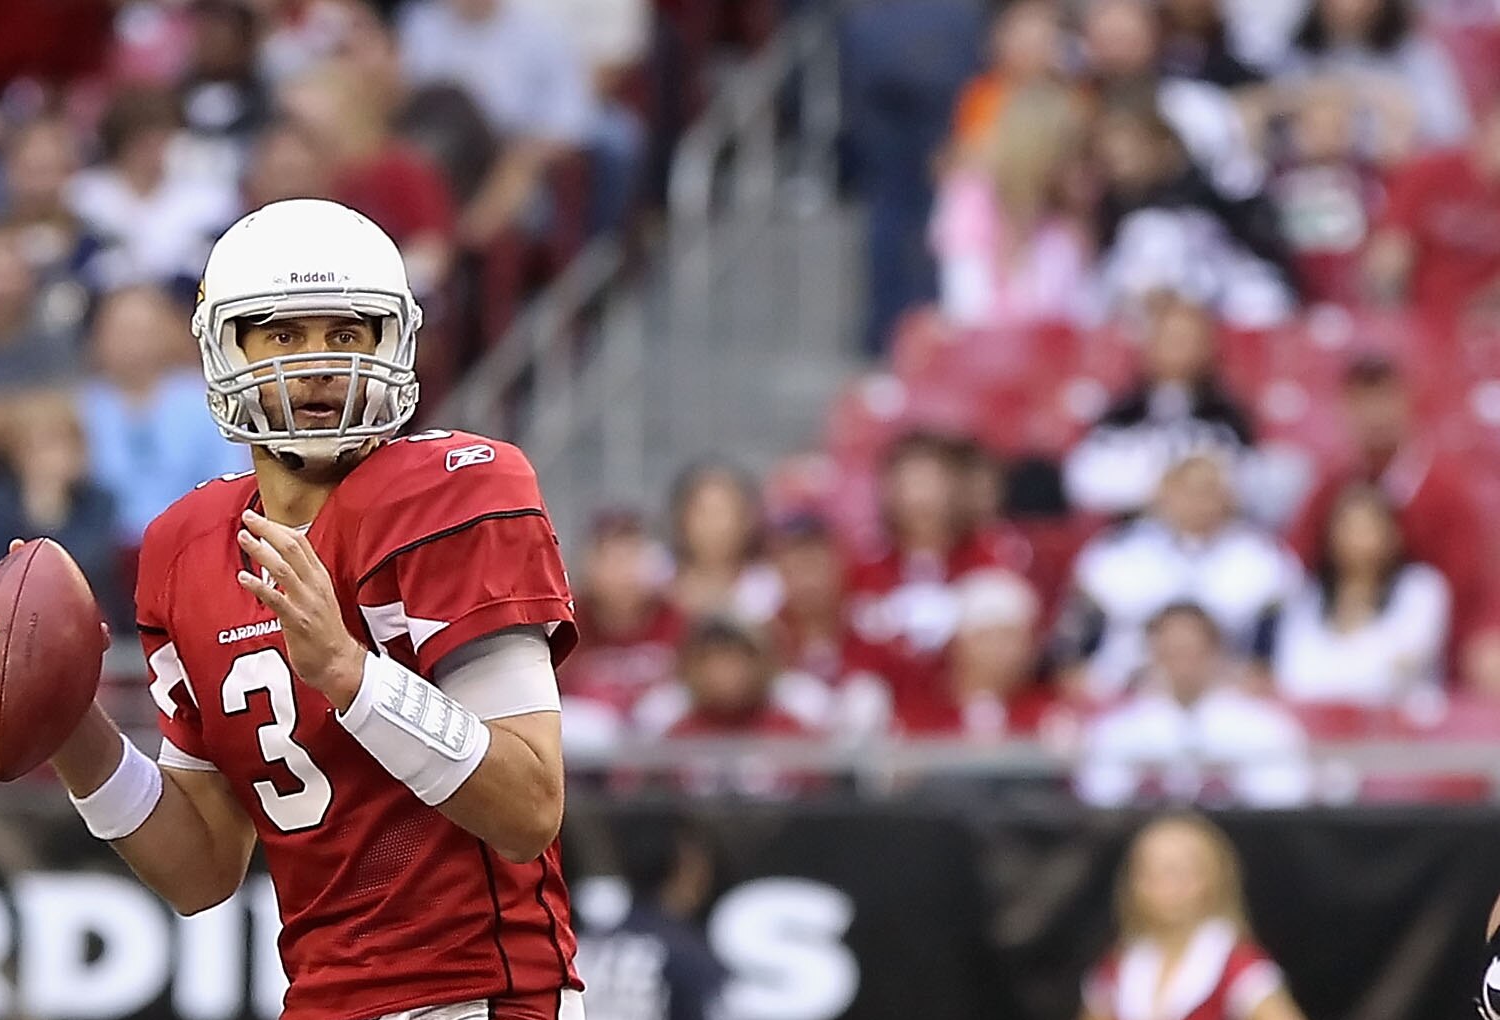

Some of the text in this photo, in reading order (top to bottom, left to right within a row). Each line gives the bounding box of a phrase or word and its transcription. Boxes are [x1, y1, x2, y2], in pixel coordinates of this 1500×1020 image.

[289, 272, 335, 284] Riddell
[218, 616, 283, 645] CARDINAL
[221, 648, 333, 832] 3
